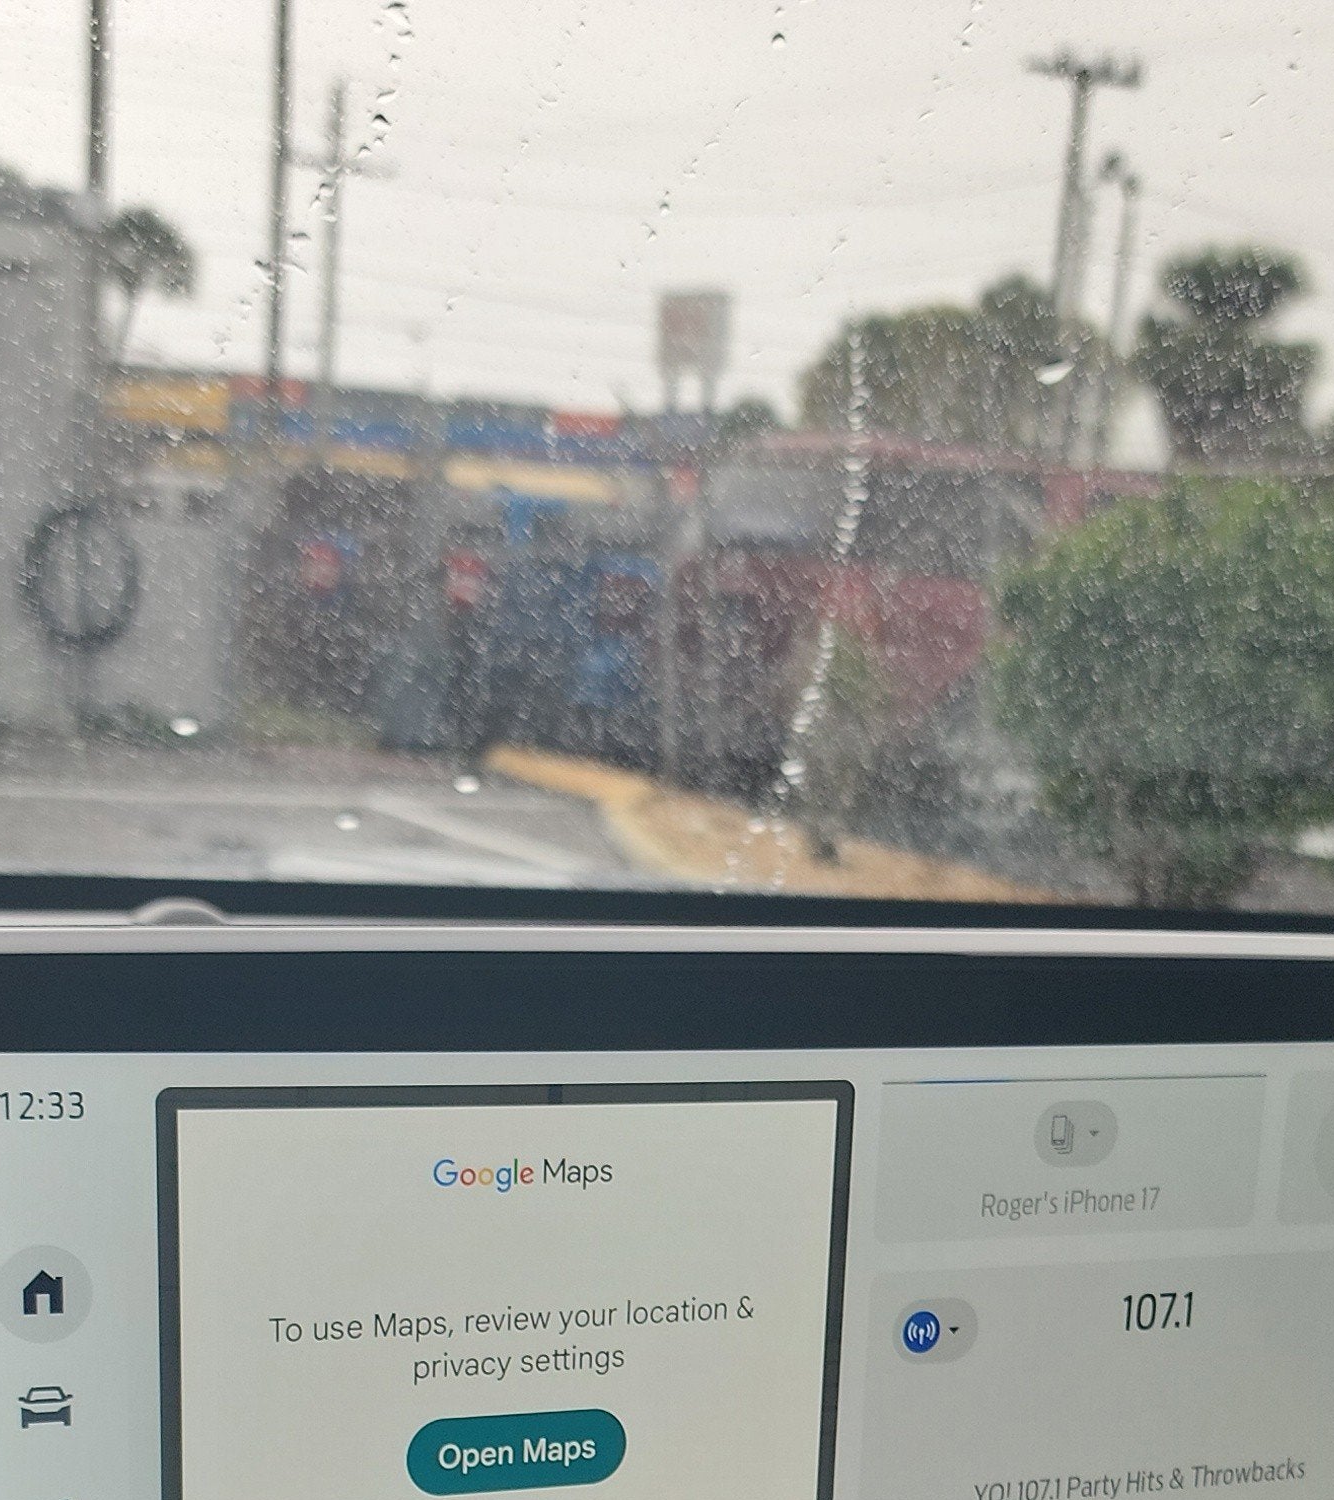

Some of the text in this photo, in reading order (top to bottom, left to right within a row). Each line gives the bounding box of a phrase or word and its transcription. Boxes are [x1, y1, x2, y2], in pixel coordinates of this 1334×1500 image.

[0, 1091, 85, 1120] 12:33
[432, 1157, 613, 1193] Google Maps
[980, 1185, 1161, 1222] Roger's iPhone 17
[268, 1294, 755, 1343] To use Maps, review your location &
[1123, 1291, 1194, 1331] 107.1
[413, 1344, 625, 1386] privacy settings
[438, 1437, 596, 1475] Open Maps
[1066, 1475, 1122, 1500] Party
[1126, 1471, 1164, 1493] Hits
[1168, 1467, 1184, 1490] &
[1191, 1457, 1306, 1488] Throwbacks
